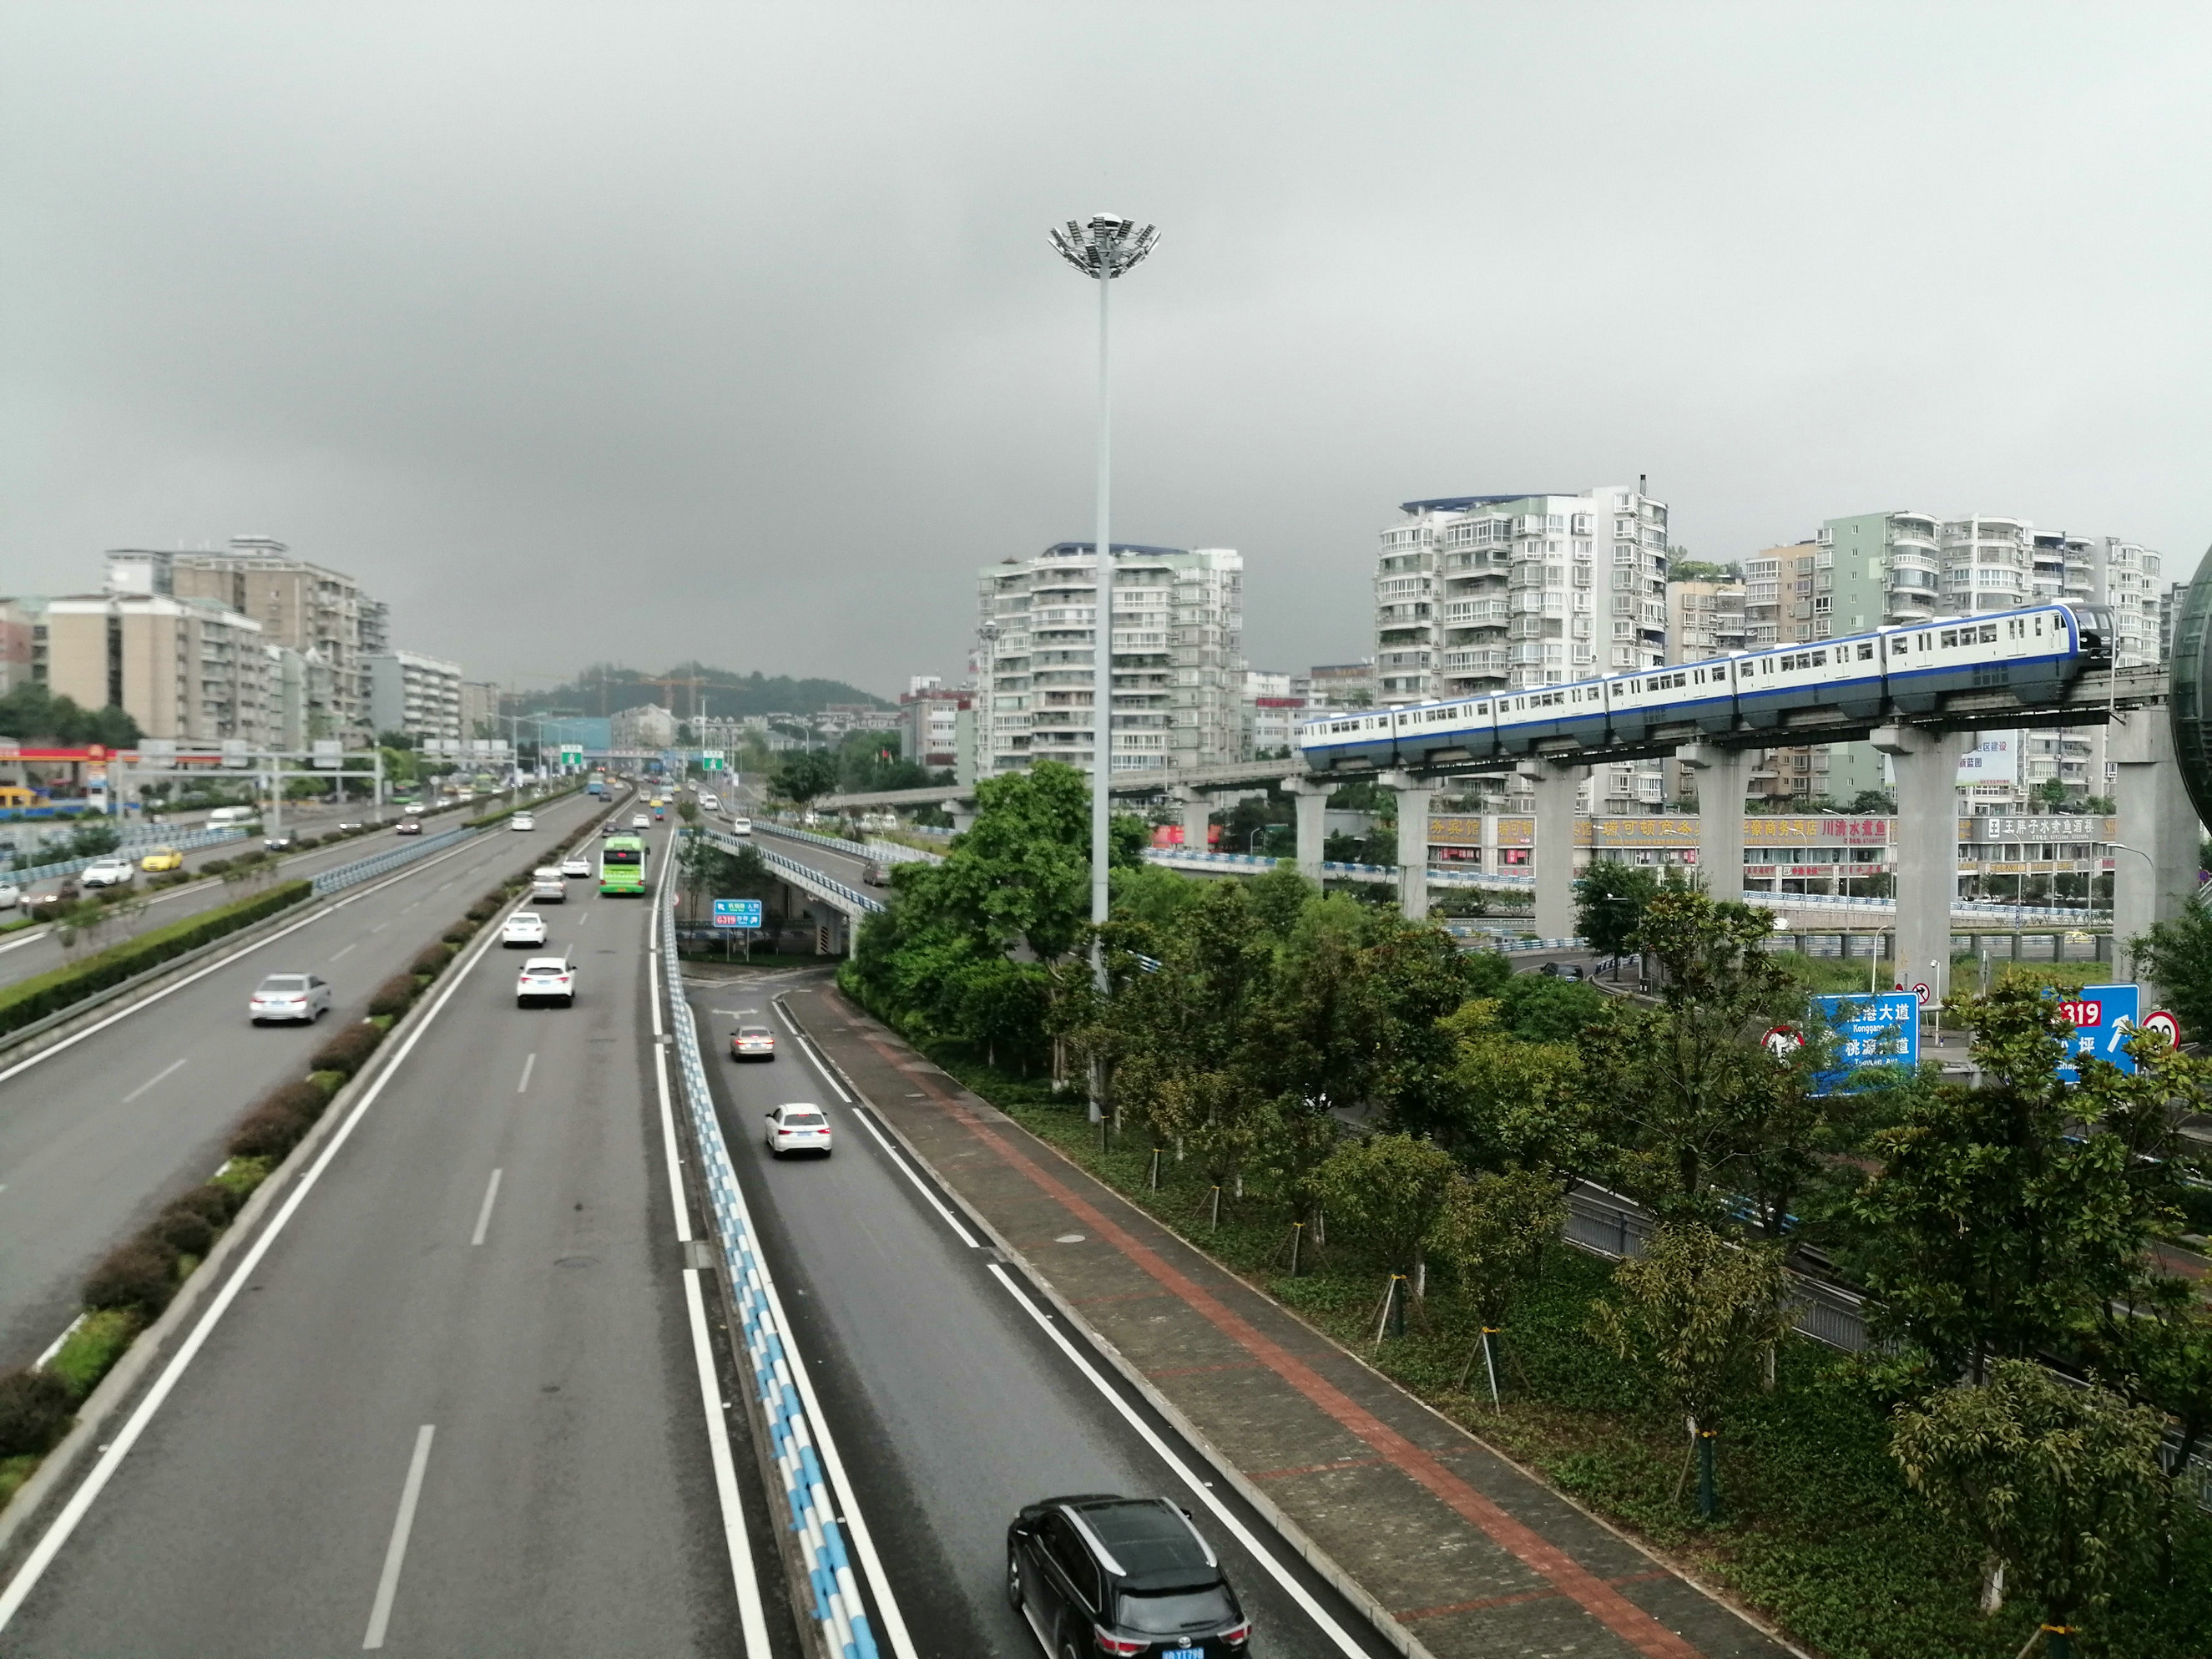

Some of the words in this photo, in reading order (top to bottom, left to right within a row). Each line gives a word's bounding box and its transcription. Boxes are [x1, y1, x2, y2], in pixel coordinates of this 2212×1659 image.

[1602, 819, 1699, 837] 瑞可顿商务
[2057, 1004, 2099, 1025] 319
[1846, 1037, 1910, 1056] 桃源道
